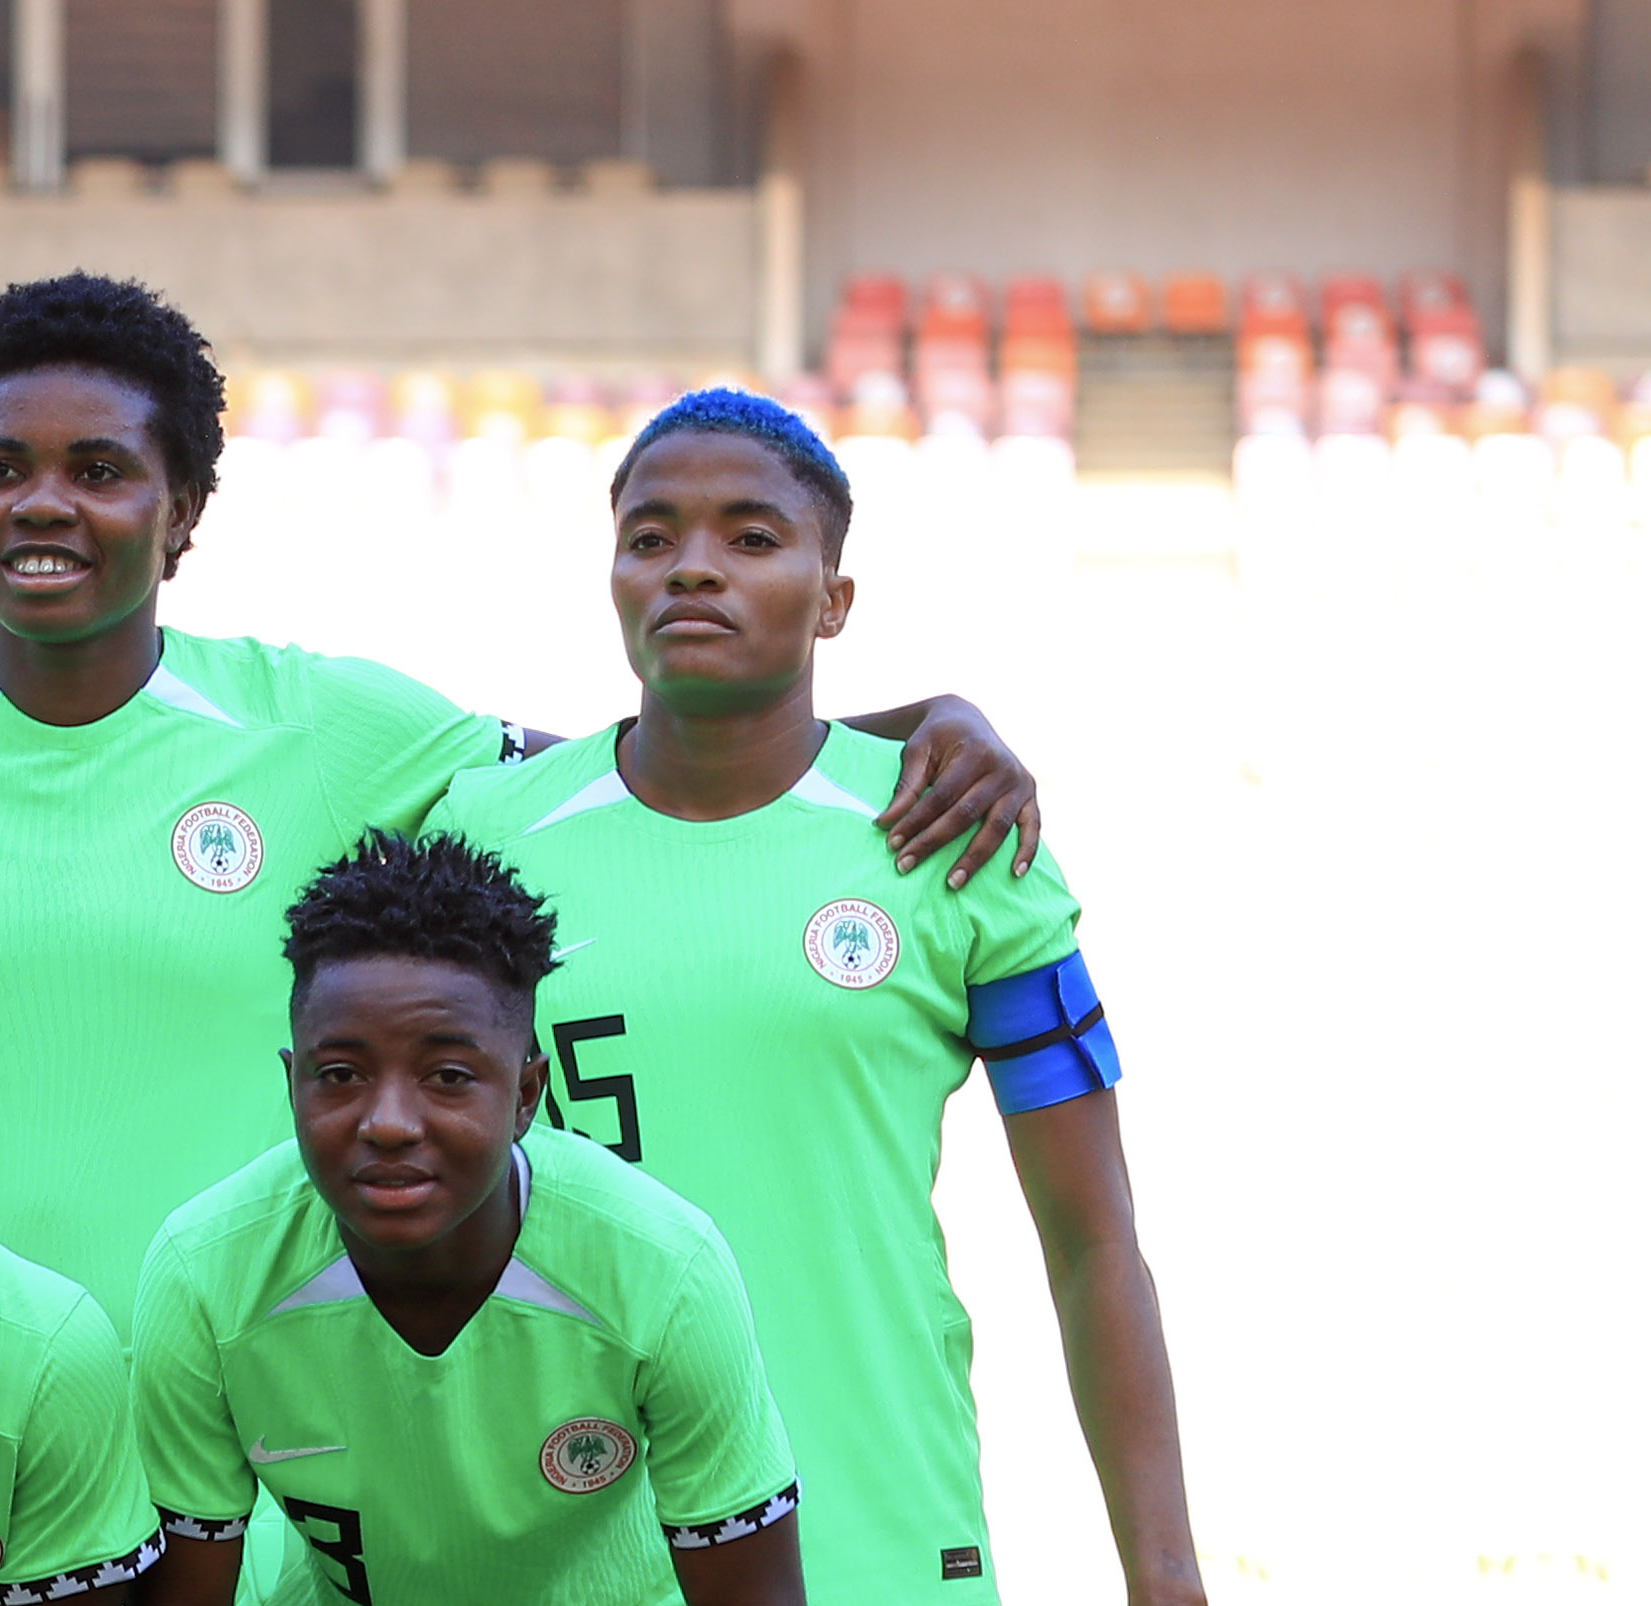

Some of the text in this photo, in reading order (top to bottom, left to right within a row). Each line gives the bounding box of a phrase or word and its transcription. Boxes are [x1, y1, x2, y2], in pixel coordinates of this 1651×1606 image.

[177, 806, 258, 876] NIGERIA FOOTBALL FEDERATION
[211, 878, 233, 888] 1945
[809, 903, 893, 975] NIGERIA FOOTBALL FEDERATION
[841, 974, 863, 984] 1945
[547, 1423, 599, 1450] FOOTBALL
